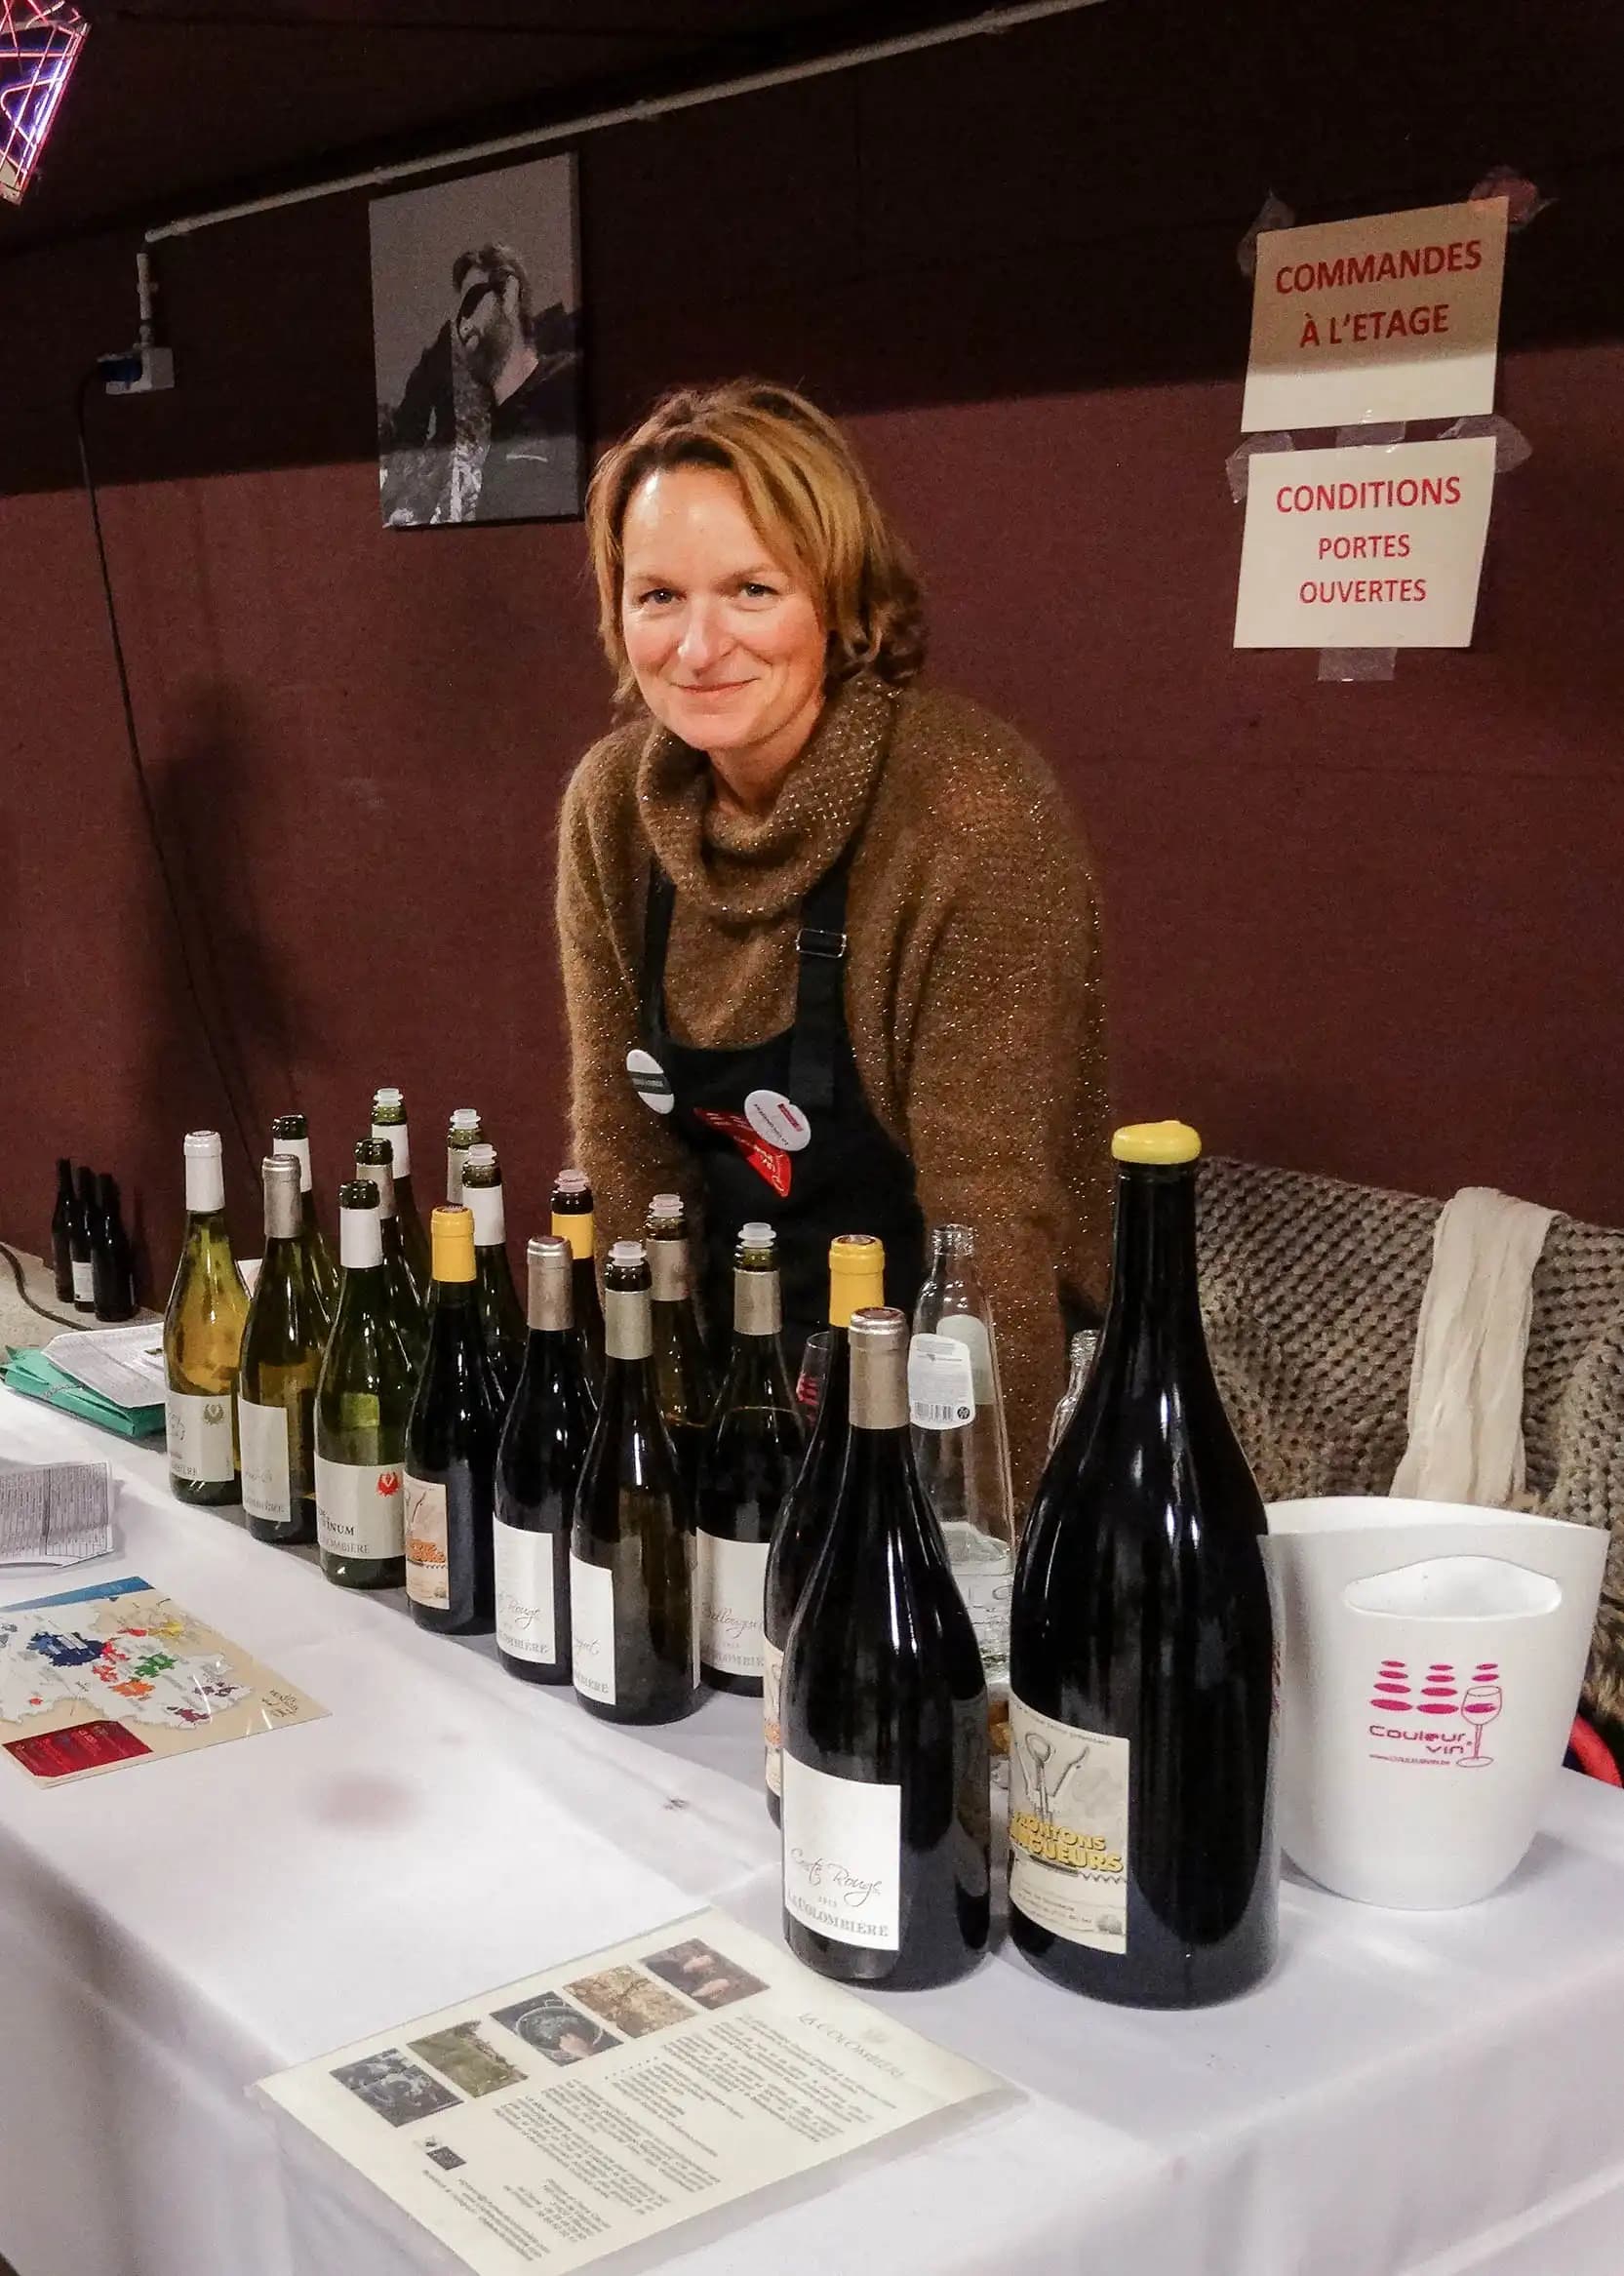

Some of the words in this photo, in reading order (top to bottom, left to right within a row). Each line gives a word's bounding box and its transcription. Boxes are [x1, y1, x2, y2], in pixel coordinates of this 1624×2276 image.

[1275, 239, 1482, 294] COMMANDES
[1300, 312, 1321, 348] À
[1276, 476, 1461, 513] CONDITIONS
[1319, 534, 1410, 560] PORTES
[1299, 579, 1427, 604] OUVERTES
[1369, 1725, 1466, 1742] Couleur
[1426, 1744, 1464, 1755] vin
[827, 1862, 884, 1907] Rouge
